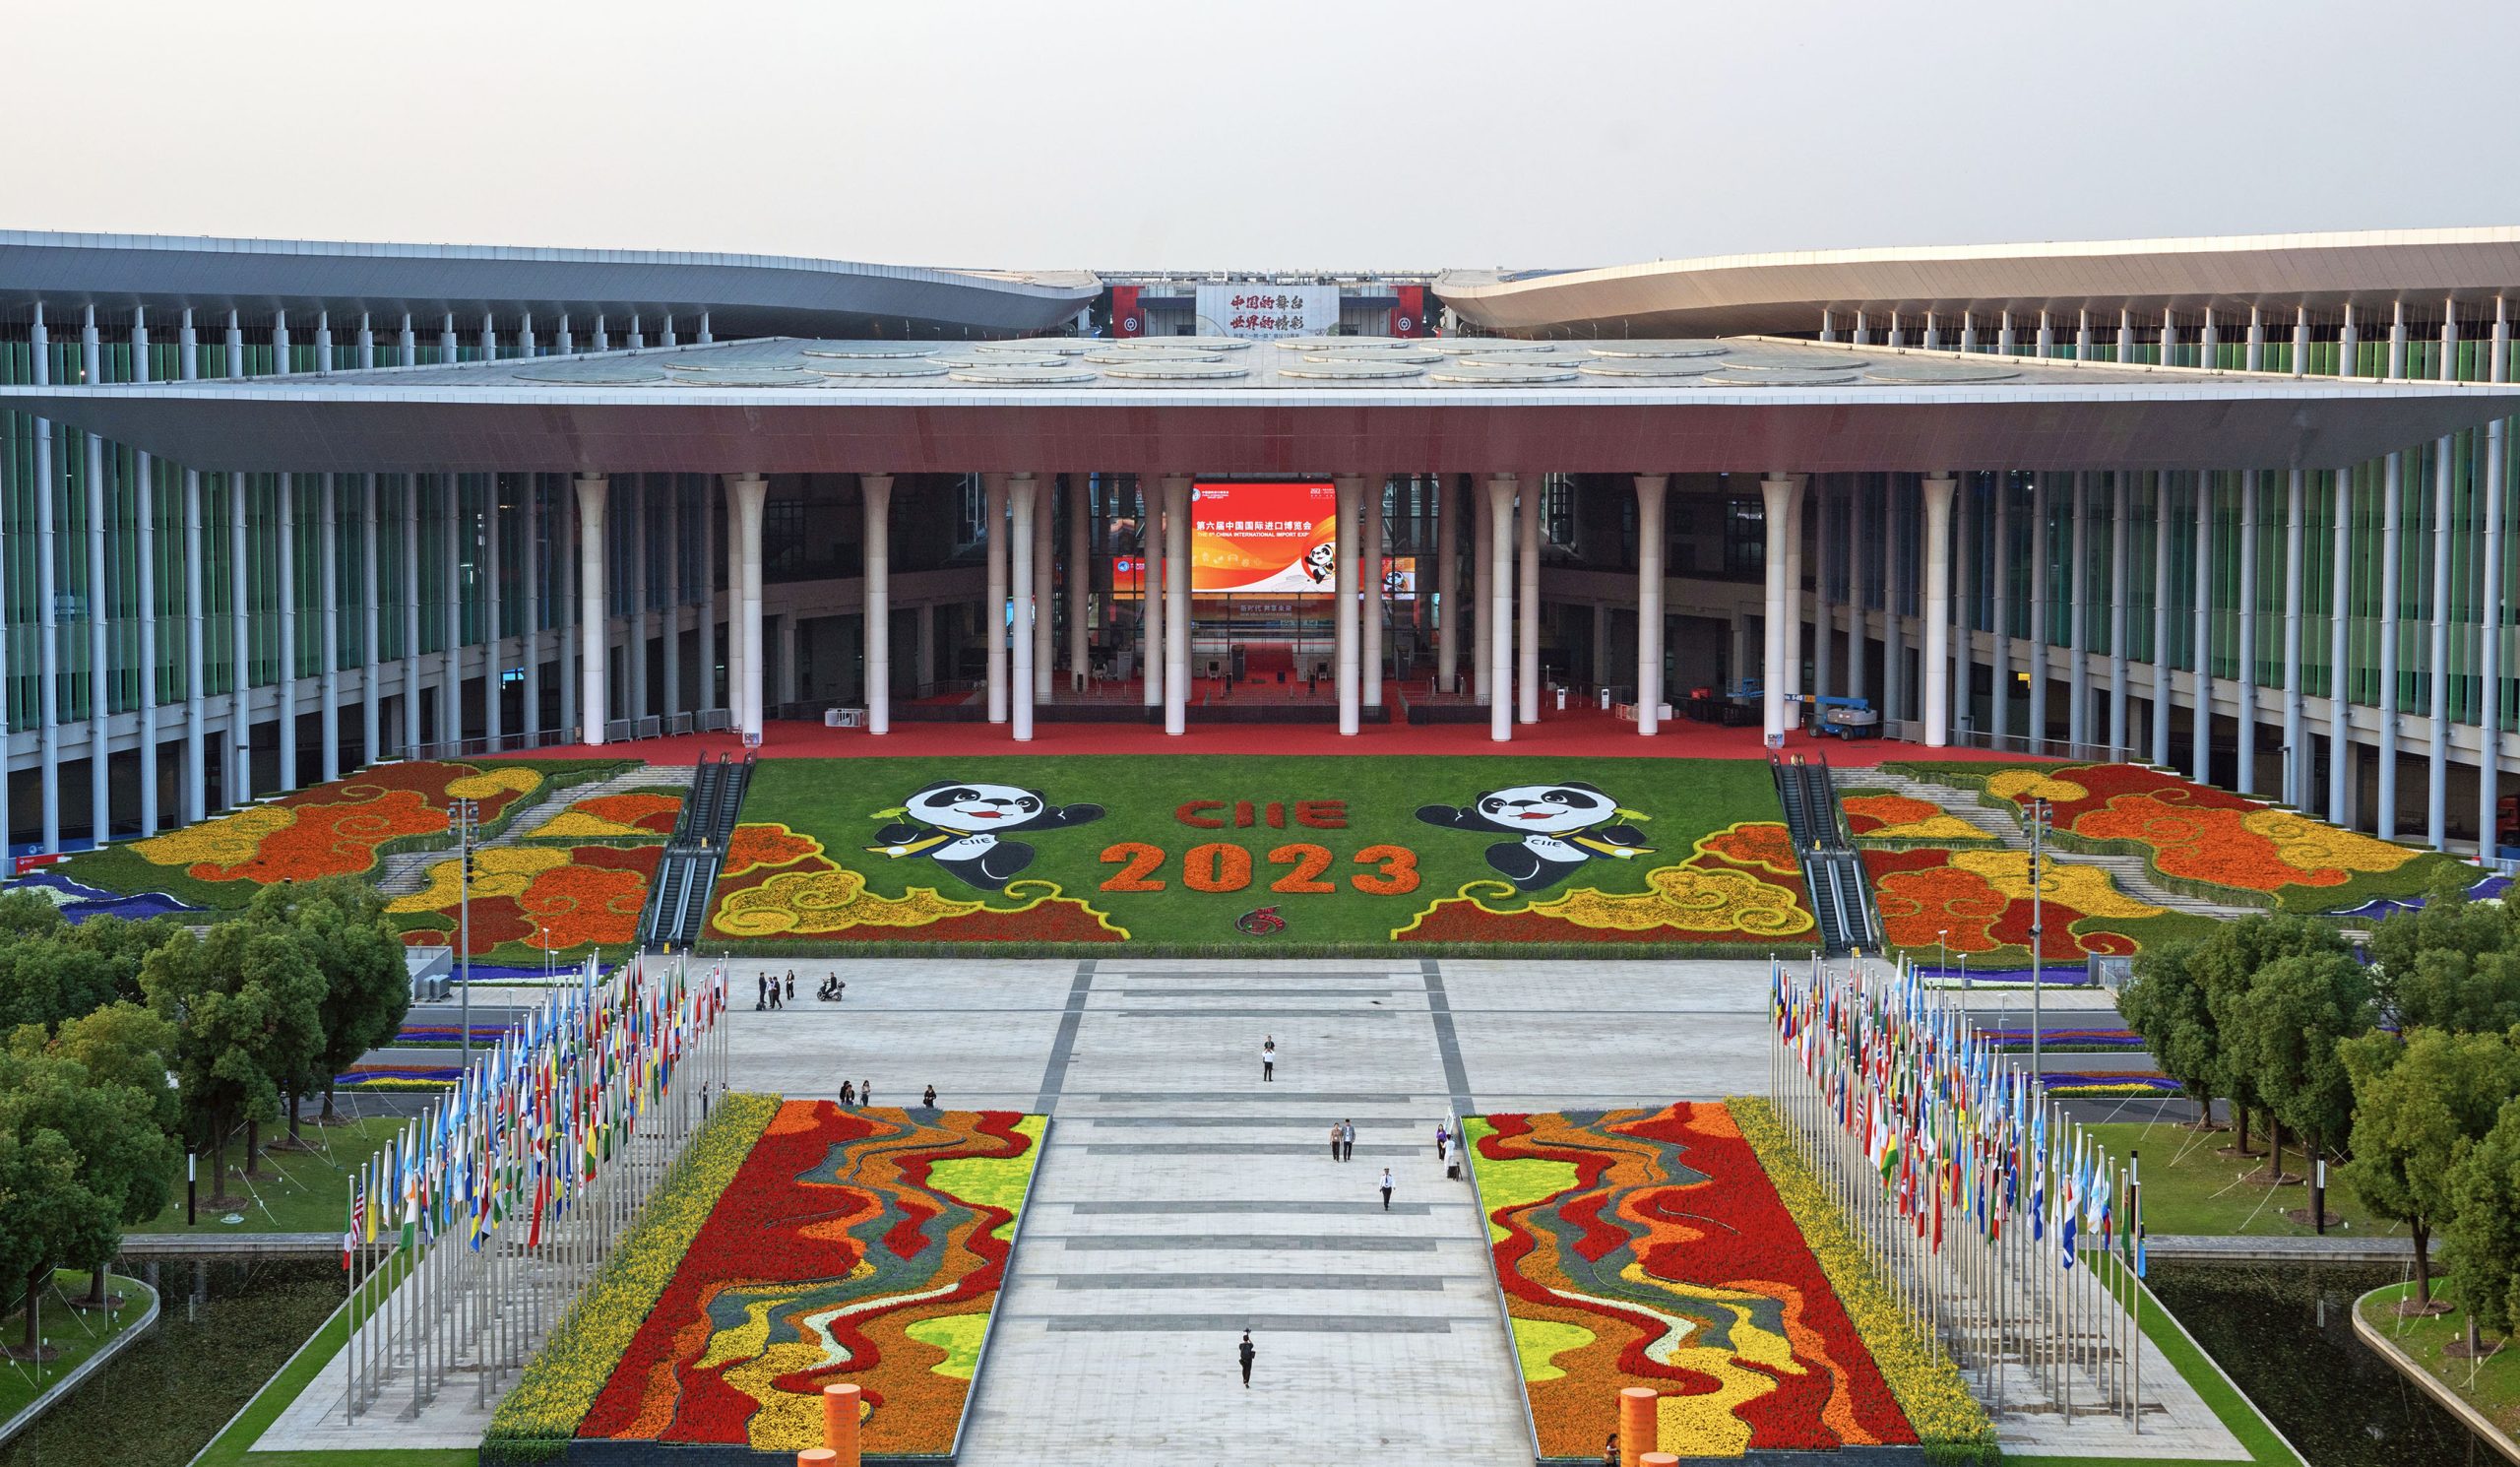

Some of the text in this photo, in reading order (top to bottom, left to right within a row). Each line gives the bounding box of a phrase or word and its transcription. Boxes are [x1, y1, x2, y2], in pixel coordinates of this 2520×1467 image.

[1230, 294, 1303, 310] 中国的舞台
[1229, 314, 1304, 331] 世界的精彩
[1196, 521, 1312, 531] 第六届中国国际进口博览会
[1175, 799, 1348, 829] CIIE
[959, 837, 991, 846] CIIE
[1531, 839, 1563, 848] CIIE
[1100, 842, 1420, 895] 2023
